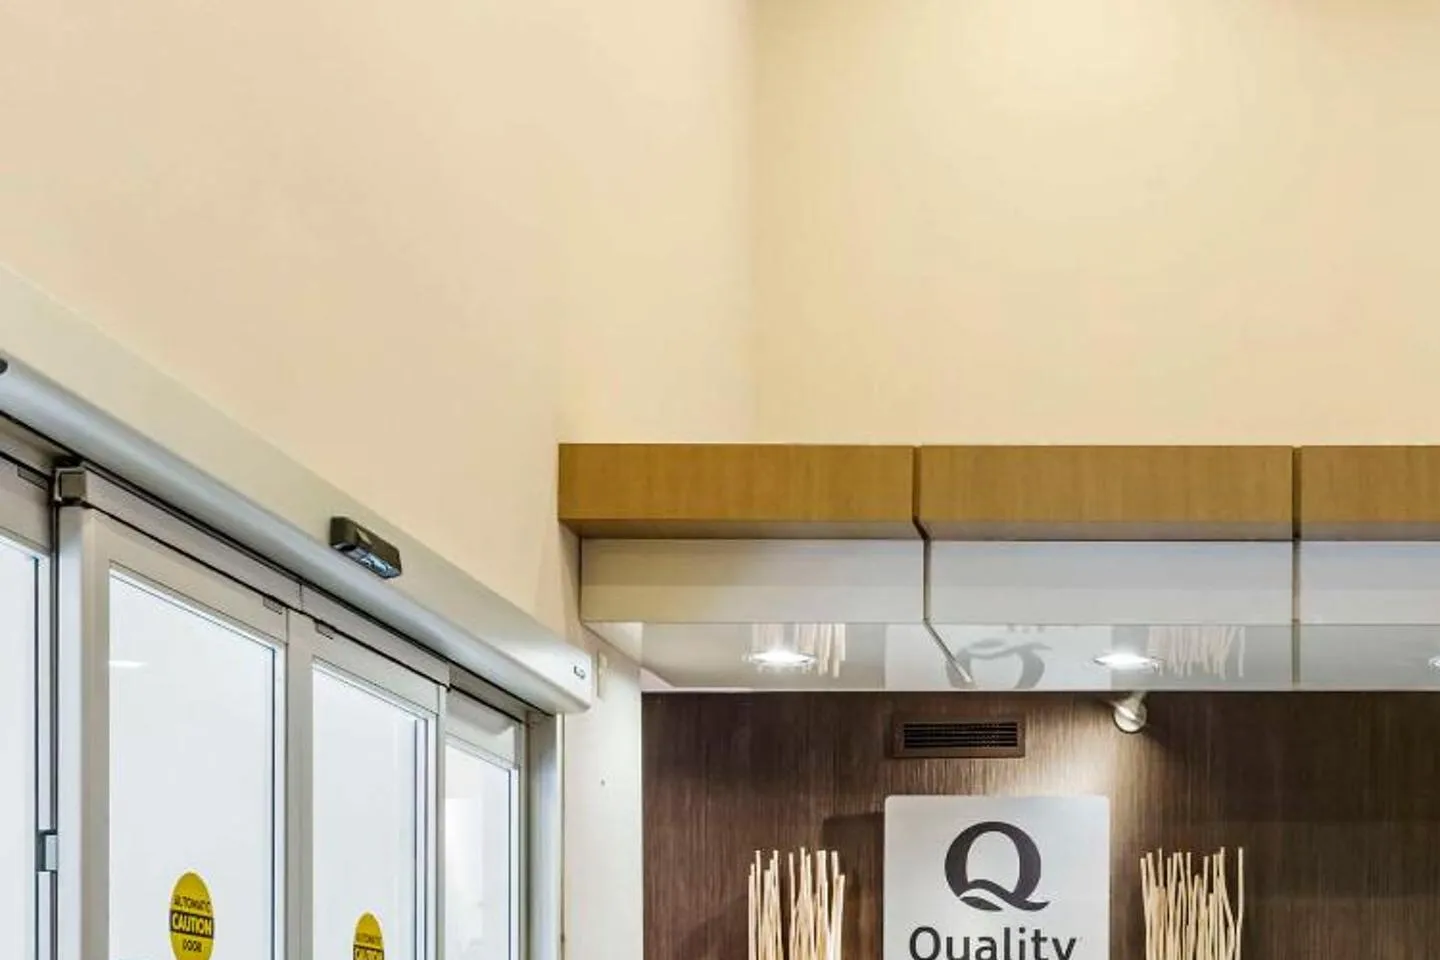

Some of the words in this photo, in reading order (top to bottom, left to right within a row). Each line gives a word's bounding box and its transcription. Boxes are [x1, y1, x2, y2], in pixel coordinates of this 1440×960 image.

[944, 821, 1051, 912] Q
[172, 912, 212, 936] CAUTION
[183, 939, 202, 953] DOOR
